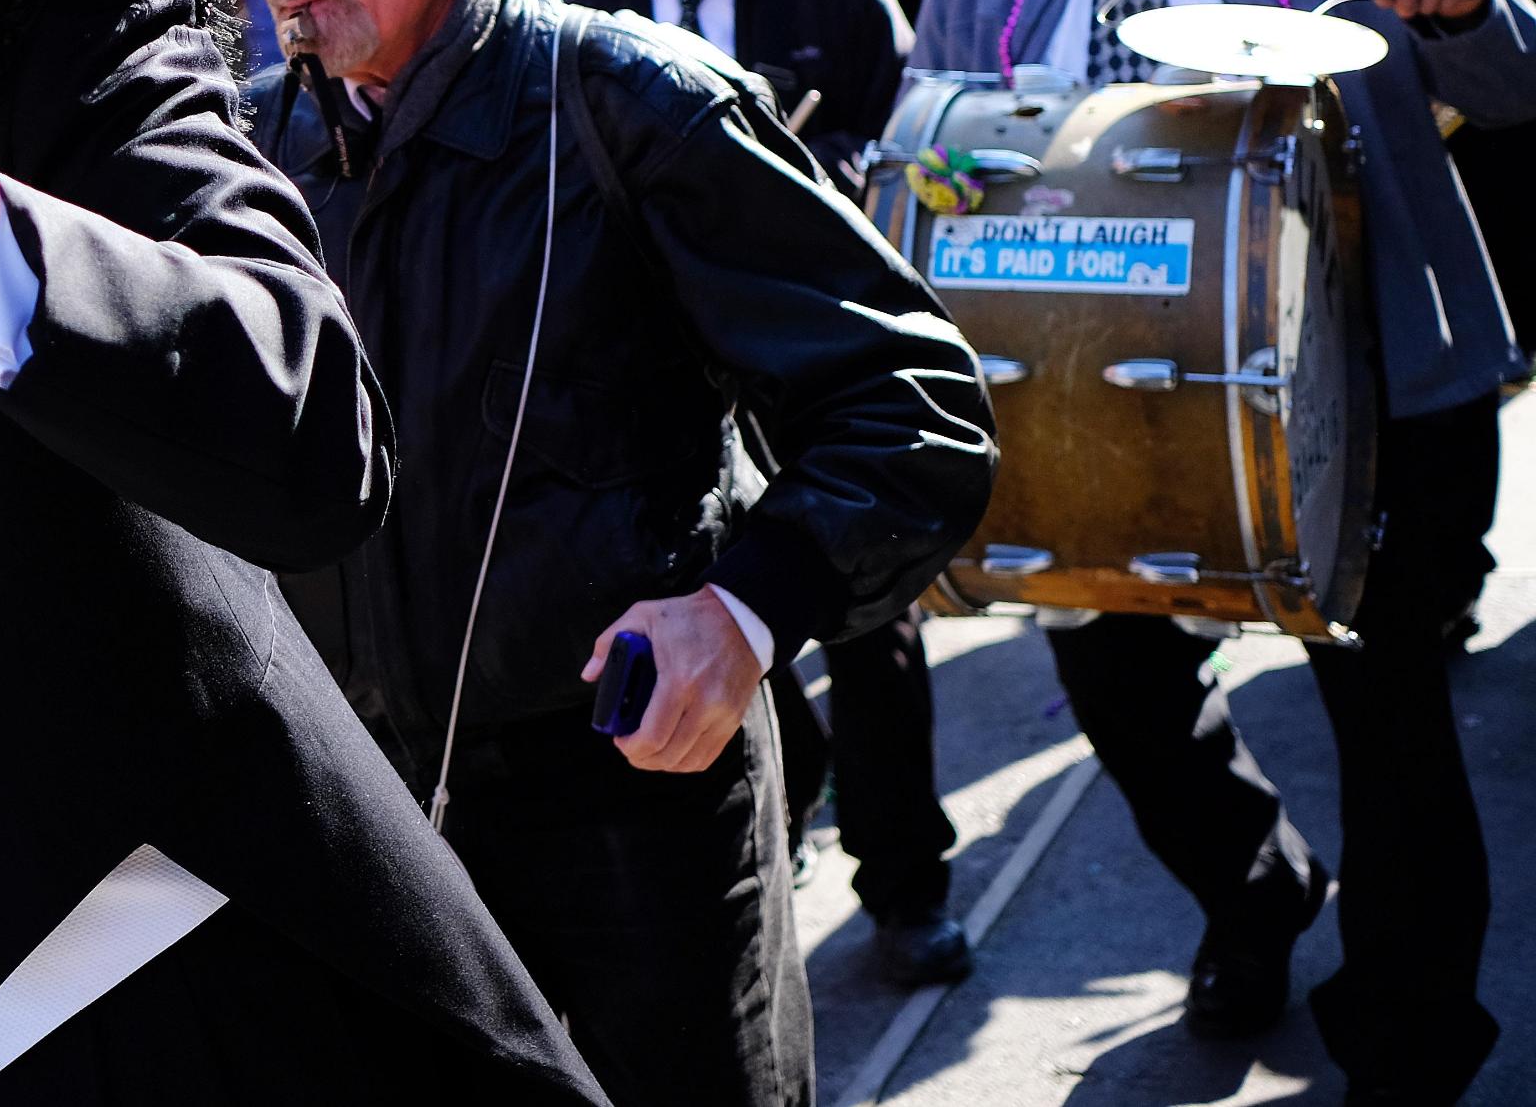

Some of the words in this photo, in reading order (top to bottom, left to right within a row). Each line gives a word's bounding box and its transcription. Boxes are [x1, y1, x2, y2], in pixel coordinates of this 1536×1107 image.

[982, 219, 1065, 245] DON'T
[1076, 222, 1168, 247] LAUGH
[940, 247, 986, 275] IT'S
[997, 248, 1055, 276] PAID
[1066, 250, 1126, 278] FOR!
